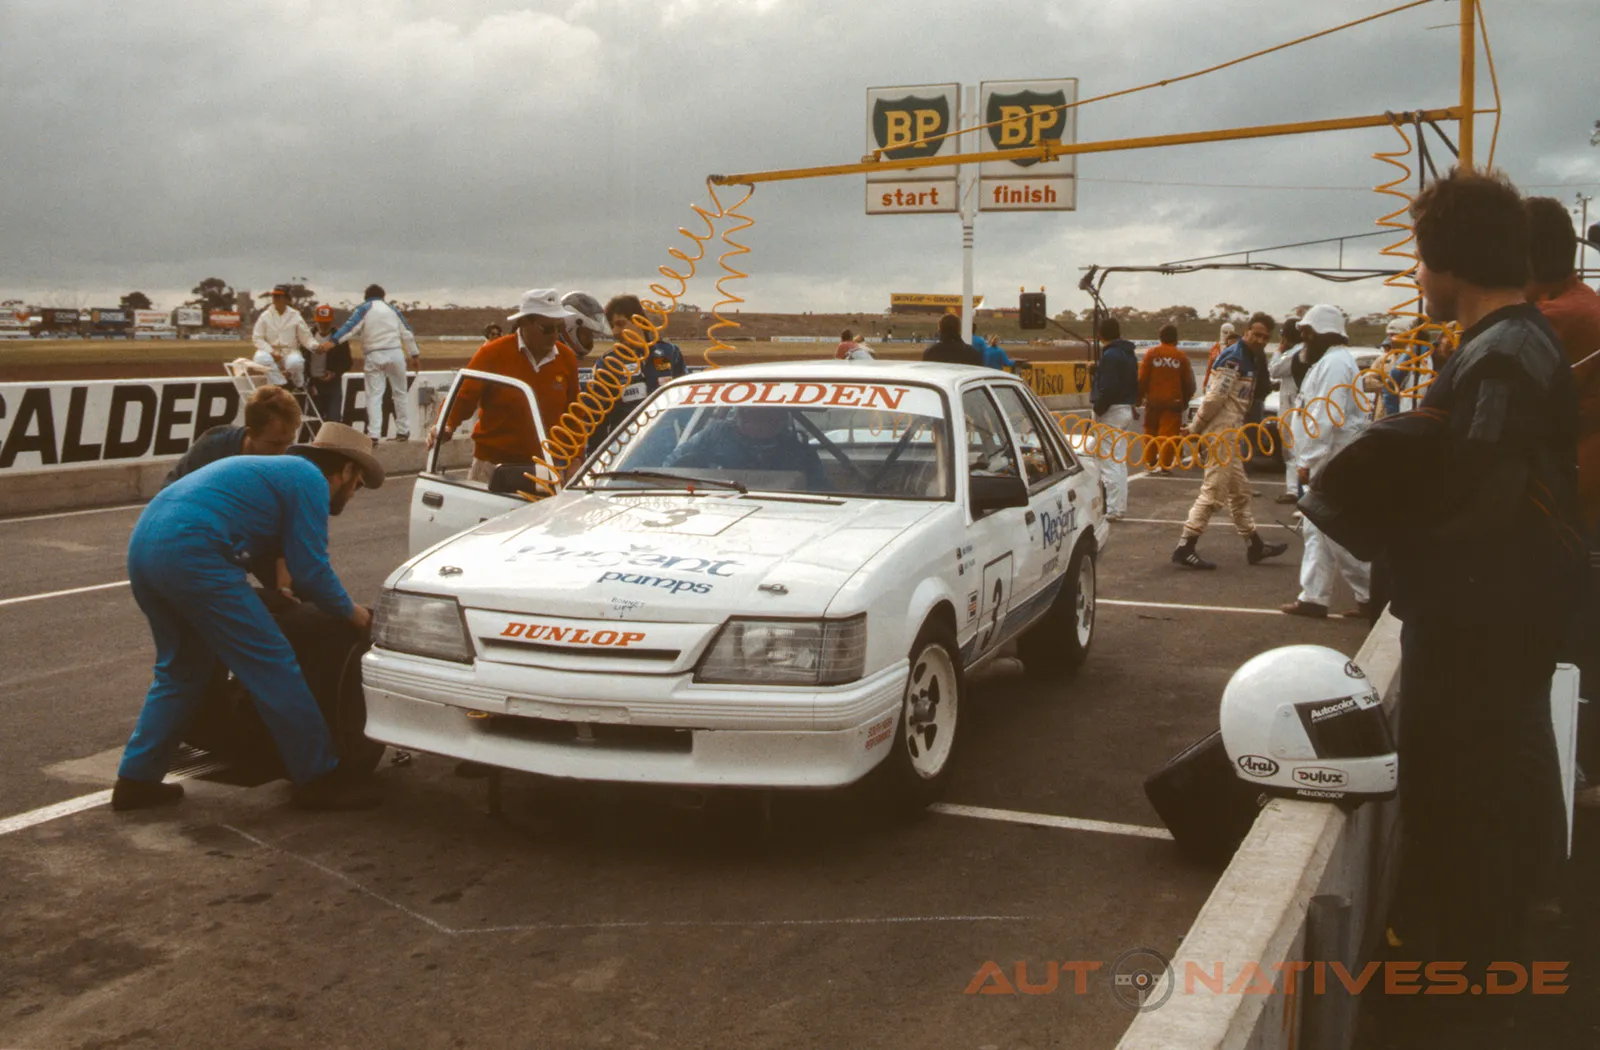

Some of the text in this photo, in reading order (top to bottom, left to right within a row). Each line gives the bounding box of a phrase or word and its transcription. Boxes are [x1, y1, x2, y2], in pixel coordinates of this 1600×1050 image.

[884, 109, 941, 149] BP
[999, 104, 1058, 145] BP
[881, 187, 939, 207] start
[994, 184, 1056, 204] finish
[1035, 368, 1064, 395] Visco
[680, 382, 910, 410] HOLDEN
[0, 382, 243, 469] ALDER
[641, 508, 701, 528] 3
[1040, 507, 1077, 552] Regent
[597, 571, 714, 594] pumps
[980, 578, 1003, 652] 3
[500, 622, 646, 647] DUNLOP
[1311, 697, 1355, 719] Autocolor
[1241, 757, 1273, 771] Arai
